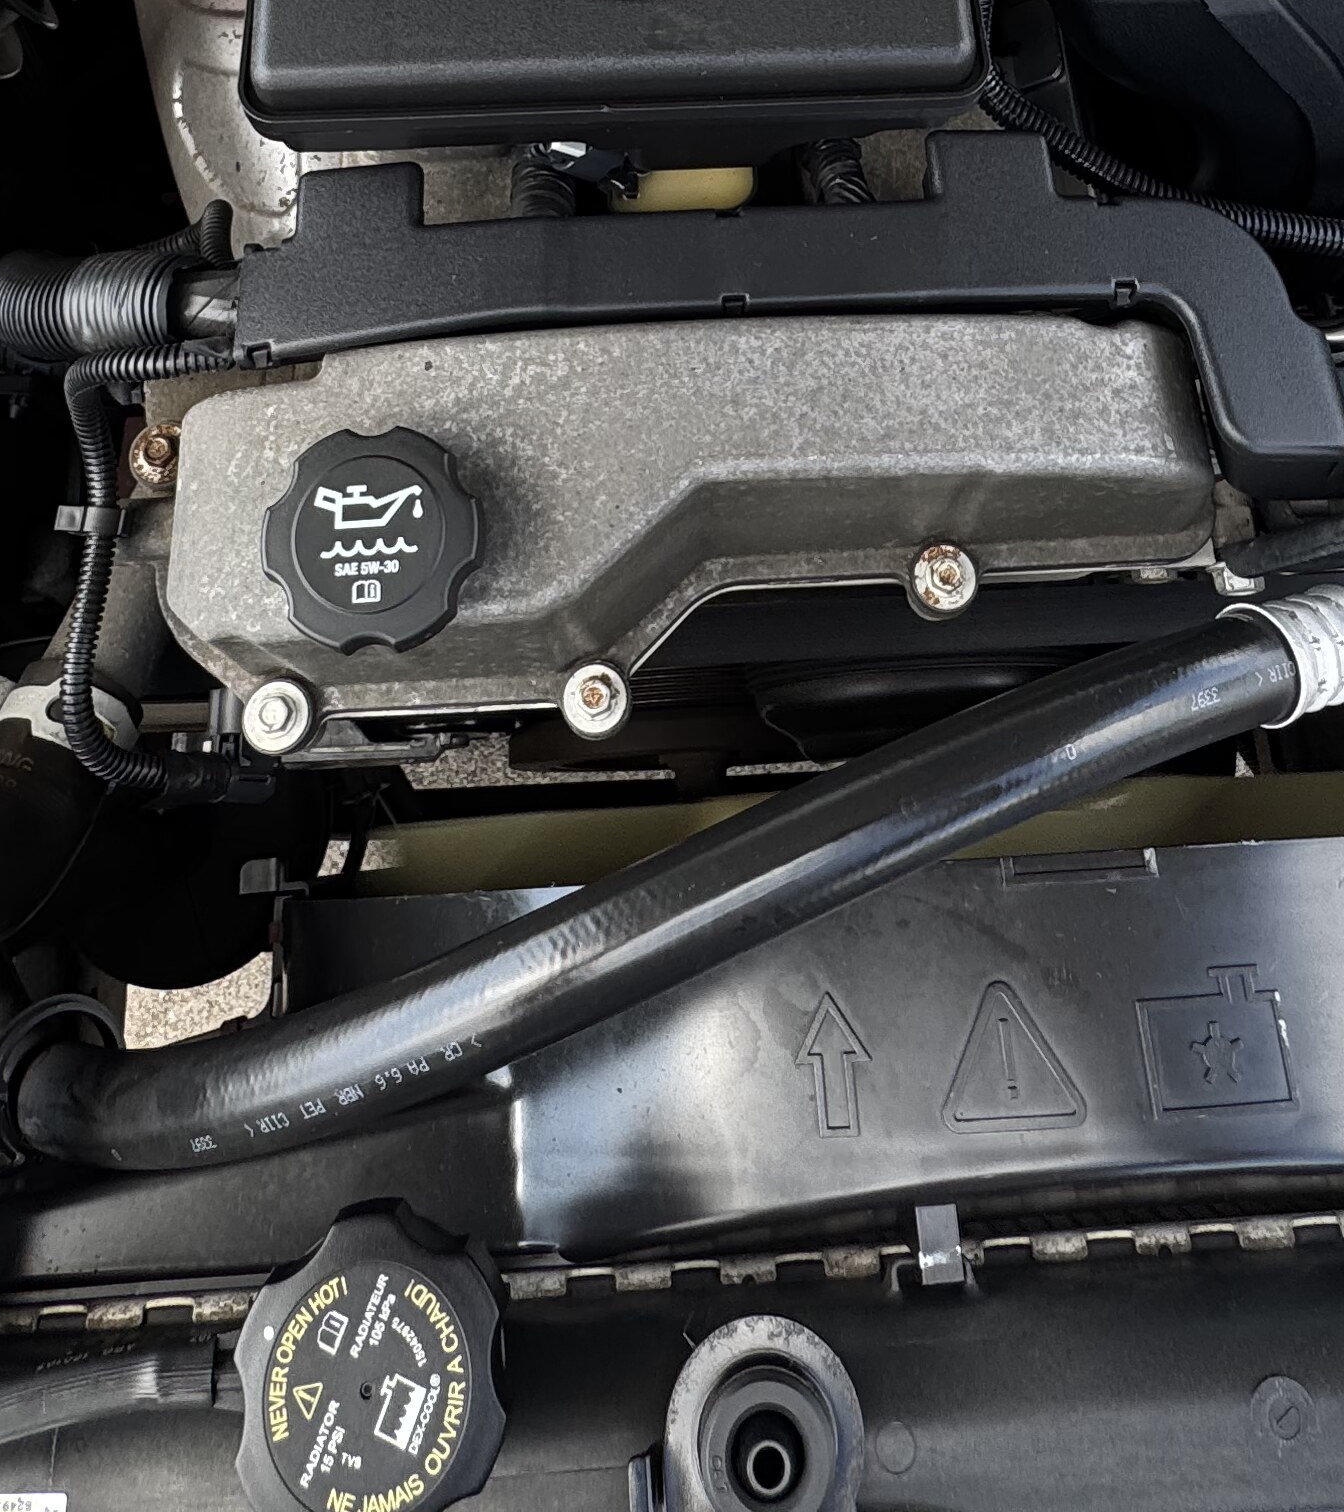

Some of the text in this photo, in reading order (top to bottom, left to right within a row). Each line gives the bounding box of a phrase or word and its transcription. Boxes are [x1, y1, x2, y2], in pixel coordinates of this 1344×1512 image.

[335, 560, 399, 576] SAE 5W-30
[1186, 685, 1221, 711] 3397
[405, 1055, 429, 1077] PA
[438, 1039, 463, 1062] CR
[334, 1082, 364, 1107] NBR
[373, 1066, 403, 1091] 6.6
[298, 1096, 325, 1119] PET
[350, 1273, 389, 1358] RADIATEUR
[369, 1294, 396, 1347] 105 kPa
[404, 1279, 459, 1353] CHAUD!
[268, 1276, 347, 1443] NEVER OPEN HOT!
[300, 1400, 340, 1489] RADIATOR
[425, 1382, 465, 1476] OUVRIR
[321, 1426, 345, 1473] 15 PSI
[326, 1488, 355, 1511] NE
[359, 1474, 424, 1512] JAMAIS
